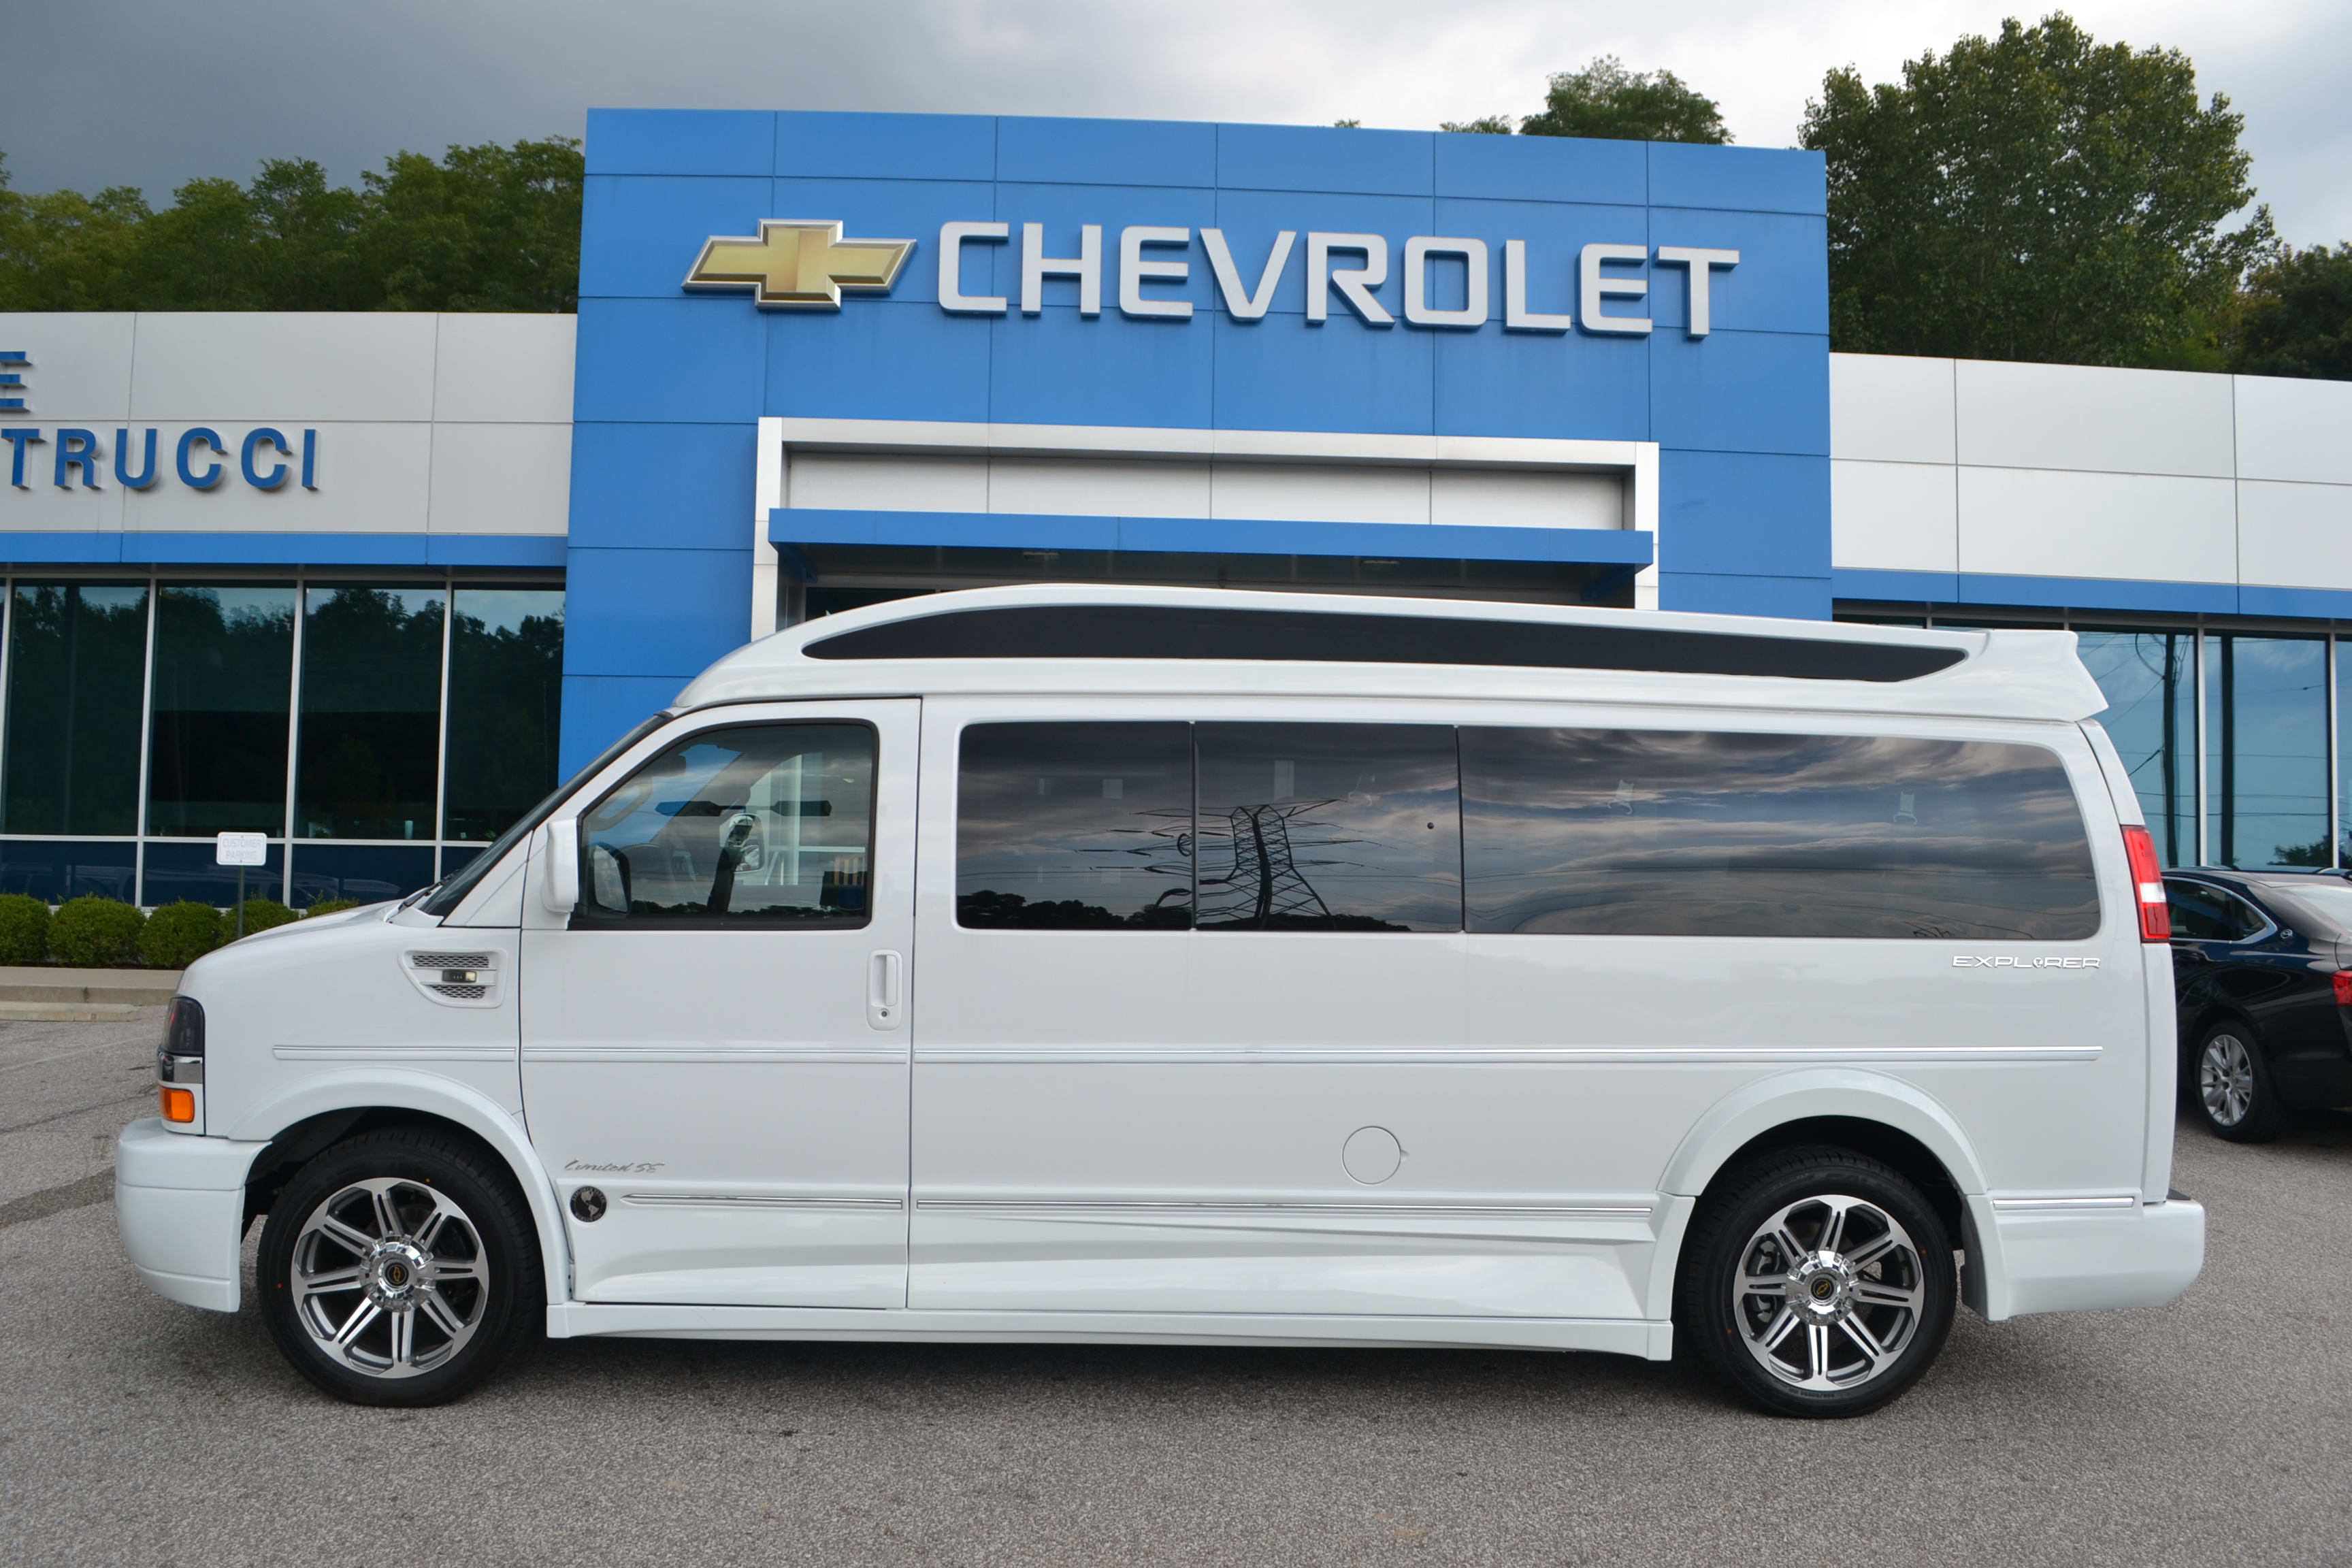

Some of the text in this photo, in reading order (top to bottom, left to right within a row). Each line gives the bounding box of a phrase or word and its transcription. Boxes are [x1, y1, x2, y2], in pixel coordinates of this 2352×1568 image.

[938, 220, 1740, 336] CHEVROLET
[1, 427, 320, 490] TRUCCI
[223, 838, 261, 848] CUSTOMER
[226, 850, 257, 860] PARKING
[564, 1158, 636, 1173] Limited
